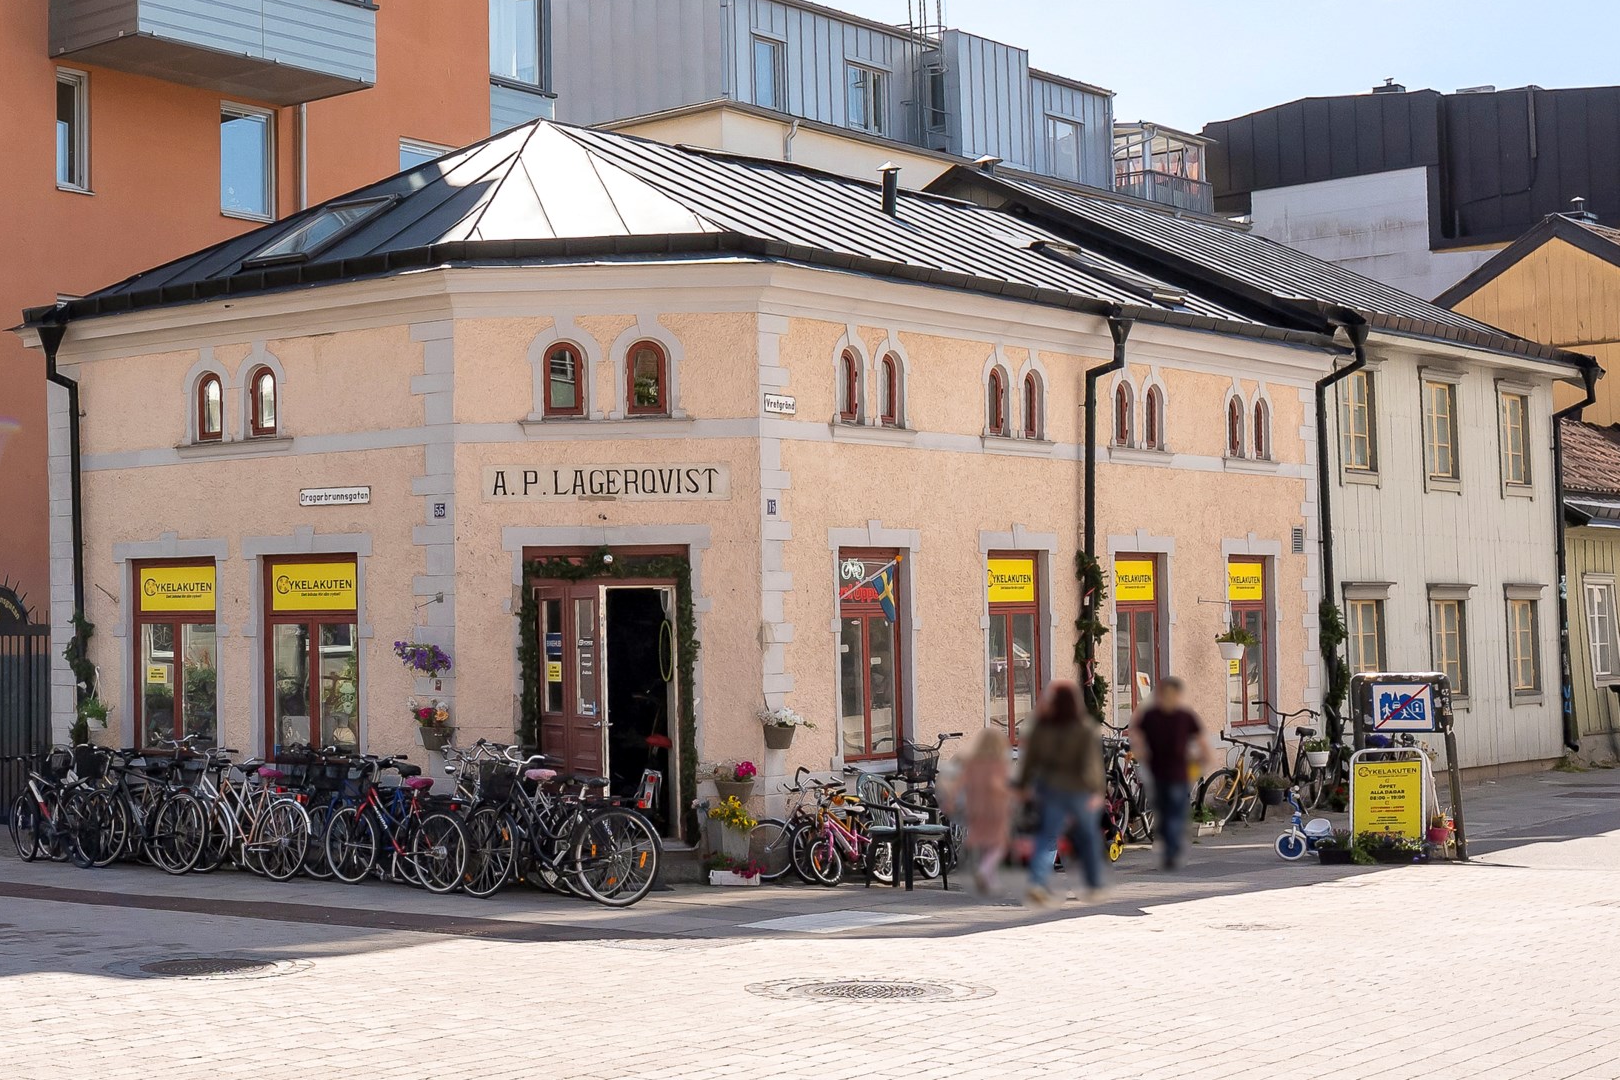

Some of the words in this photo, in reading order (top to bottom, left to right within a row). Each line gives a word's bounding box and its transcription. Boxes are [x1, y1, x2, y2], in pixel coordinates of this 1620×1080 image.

[766, 398, 795, 411] Vretgränd
[552, 468, 720, 495] LAGERQVIST
[300, 491, 369, 503] Dragarbrunnsgatan
[435, 504, 445, 517] 55
[768, 501, 776, 513] 15
[144, 578, 212, 597] CYKELAKUTEN
[276, 575, 352, 595] CYKELAKUTEN
[1358, 766, 1417, 777] CYKELAKUTEN
